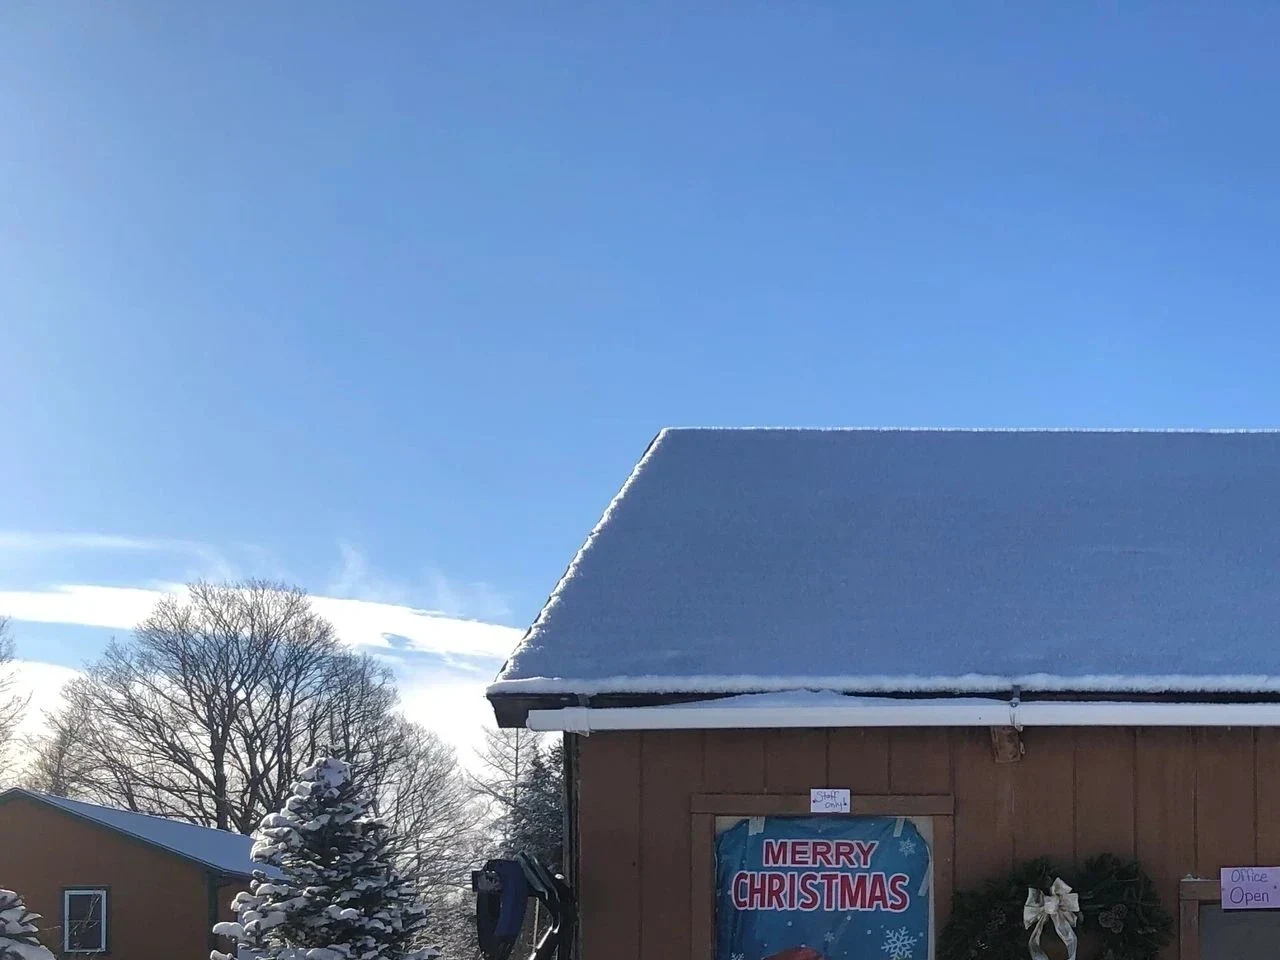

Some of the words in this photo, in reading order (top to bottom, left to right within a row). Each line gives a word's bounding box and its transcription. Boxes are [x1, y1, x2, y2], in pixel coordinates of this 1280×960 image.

[763, 839, 879, 868] MERRY
[1231, 868, 1269, 883] Office
[732, 870, 909, 912] CHRISTMAS
[1230, 886, 1269, 905] Open
